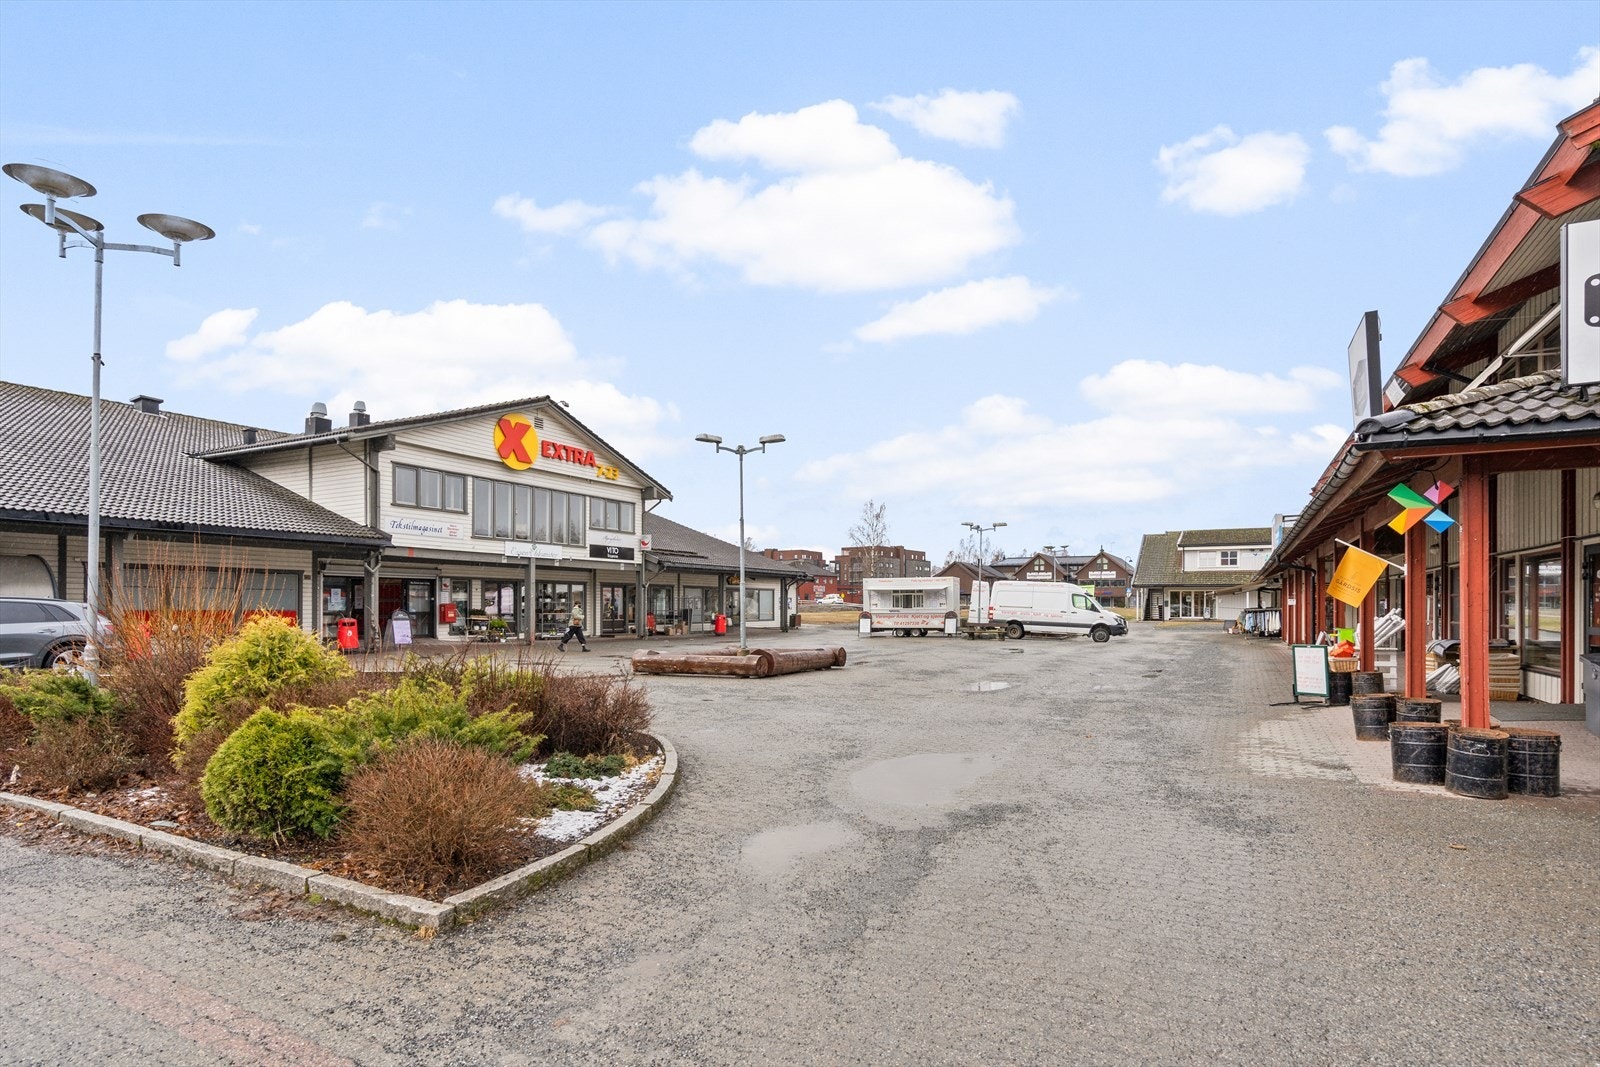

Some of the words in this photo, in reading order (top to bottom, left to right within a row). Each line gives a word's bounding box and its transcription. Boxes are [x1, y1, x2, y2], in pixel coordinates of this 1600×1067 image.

[497, 418, 533, 464] X
[541, 440, 597, 468] EXTRA
[596, 464, 620, 480] 7-23
[390, 518, 443, 535] Tekstilmagasinet
[606, 546, 619, 555] VITO
